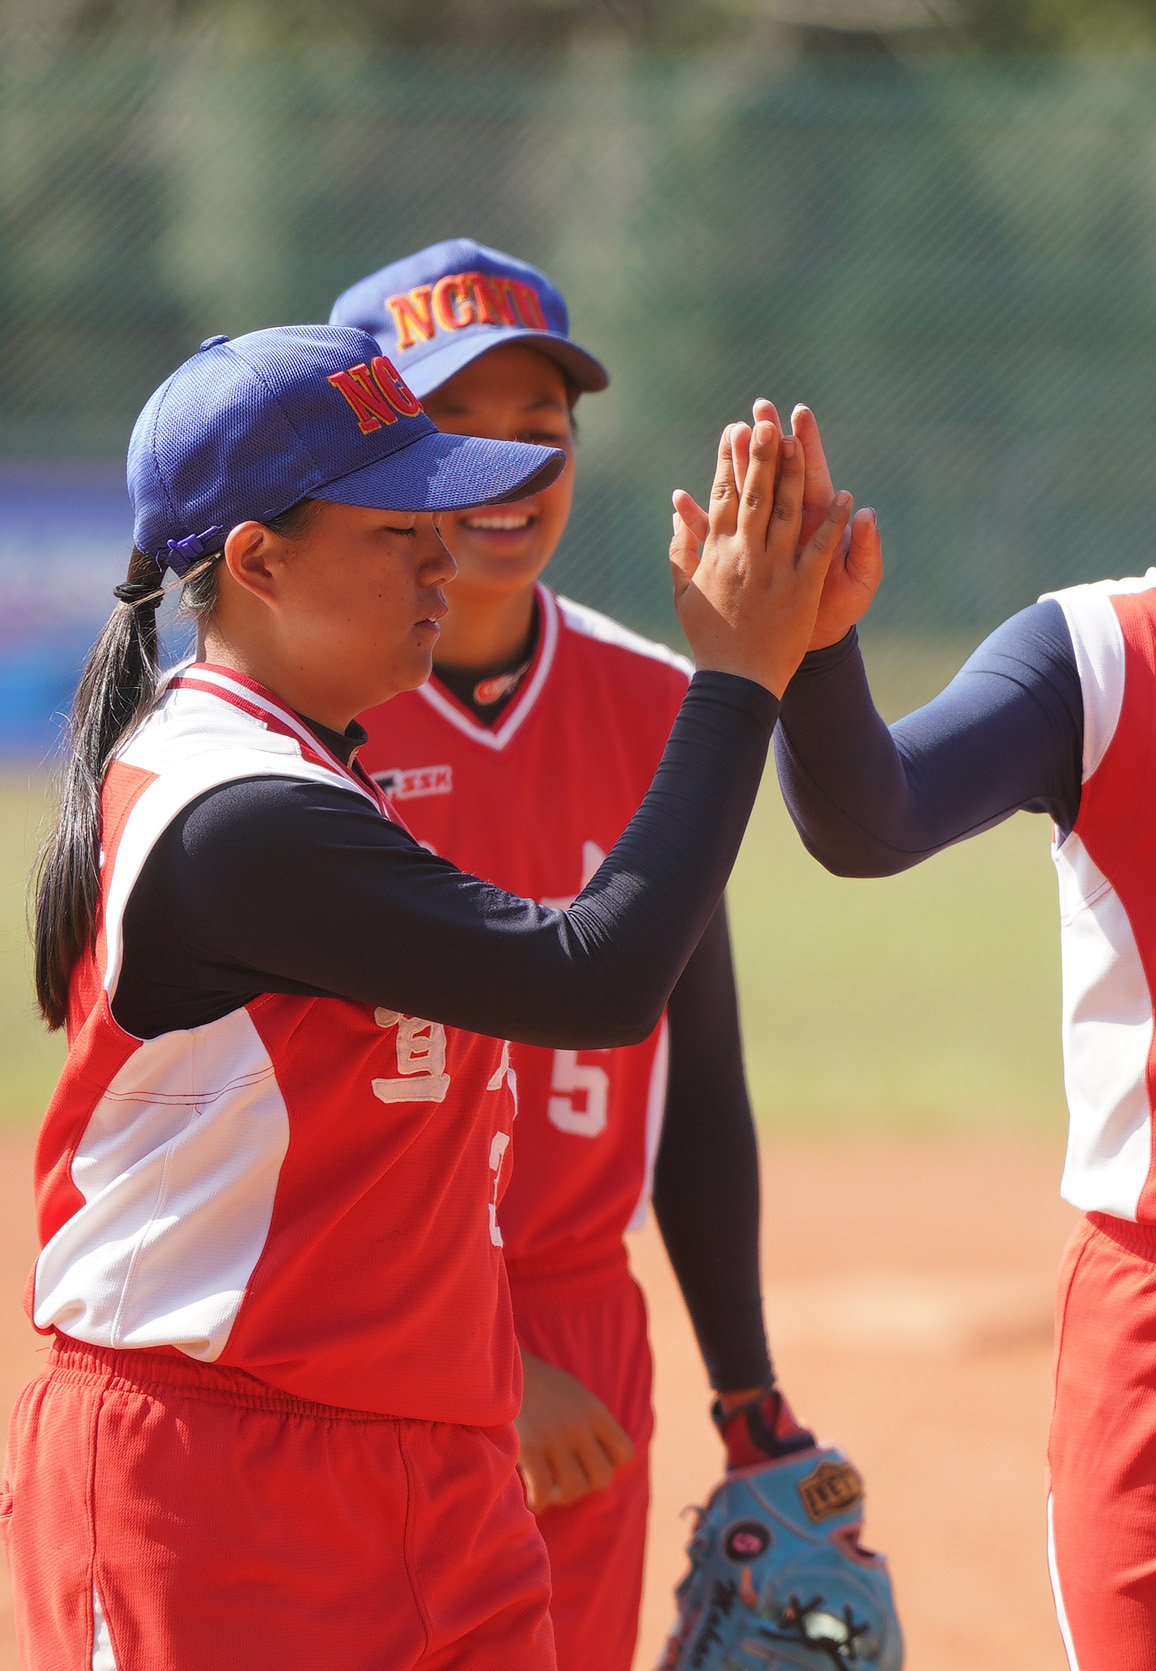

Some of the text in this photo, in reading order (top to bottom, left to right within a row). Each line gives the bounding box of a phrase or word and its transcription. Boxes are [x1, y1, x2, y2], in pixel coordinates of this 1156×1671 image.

[384, 271, 549, 353] NCNU
[327, 355, 424, 435] NC
[401, 771, 449, 793] SSK
[547, 1048, 609, 1138] 5
